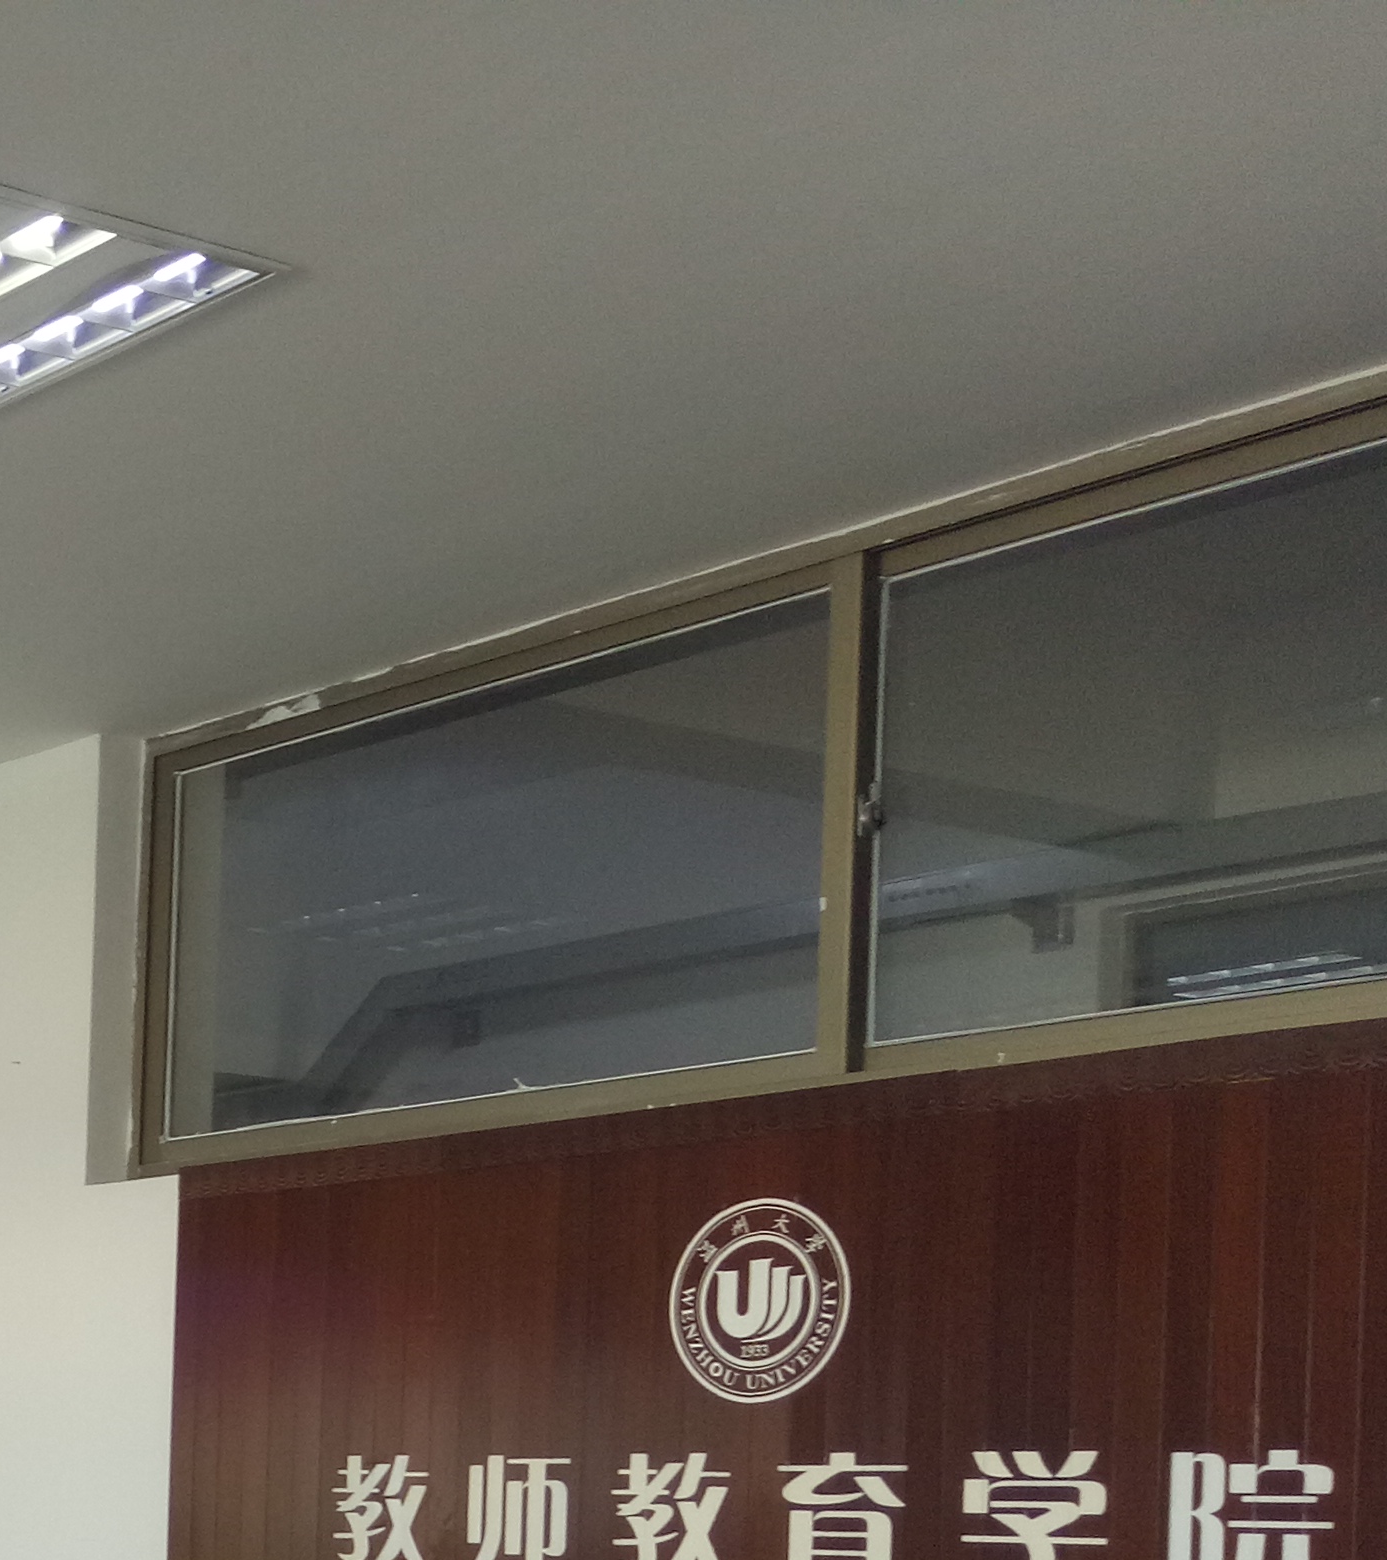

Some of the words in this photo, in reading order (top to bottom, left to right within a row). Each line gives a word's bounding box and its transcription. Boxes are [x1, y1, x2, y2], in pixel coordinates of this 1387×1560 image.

[680, 1286, 741, 1387] WENZHOU
[746, 1278, 839, 1391] UNIVERSITY
[740, 1344, 771, 1359] 1933
